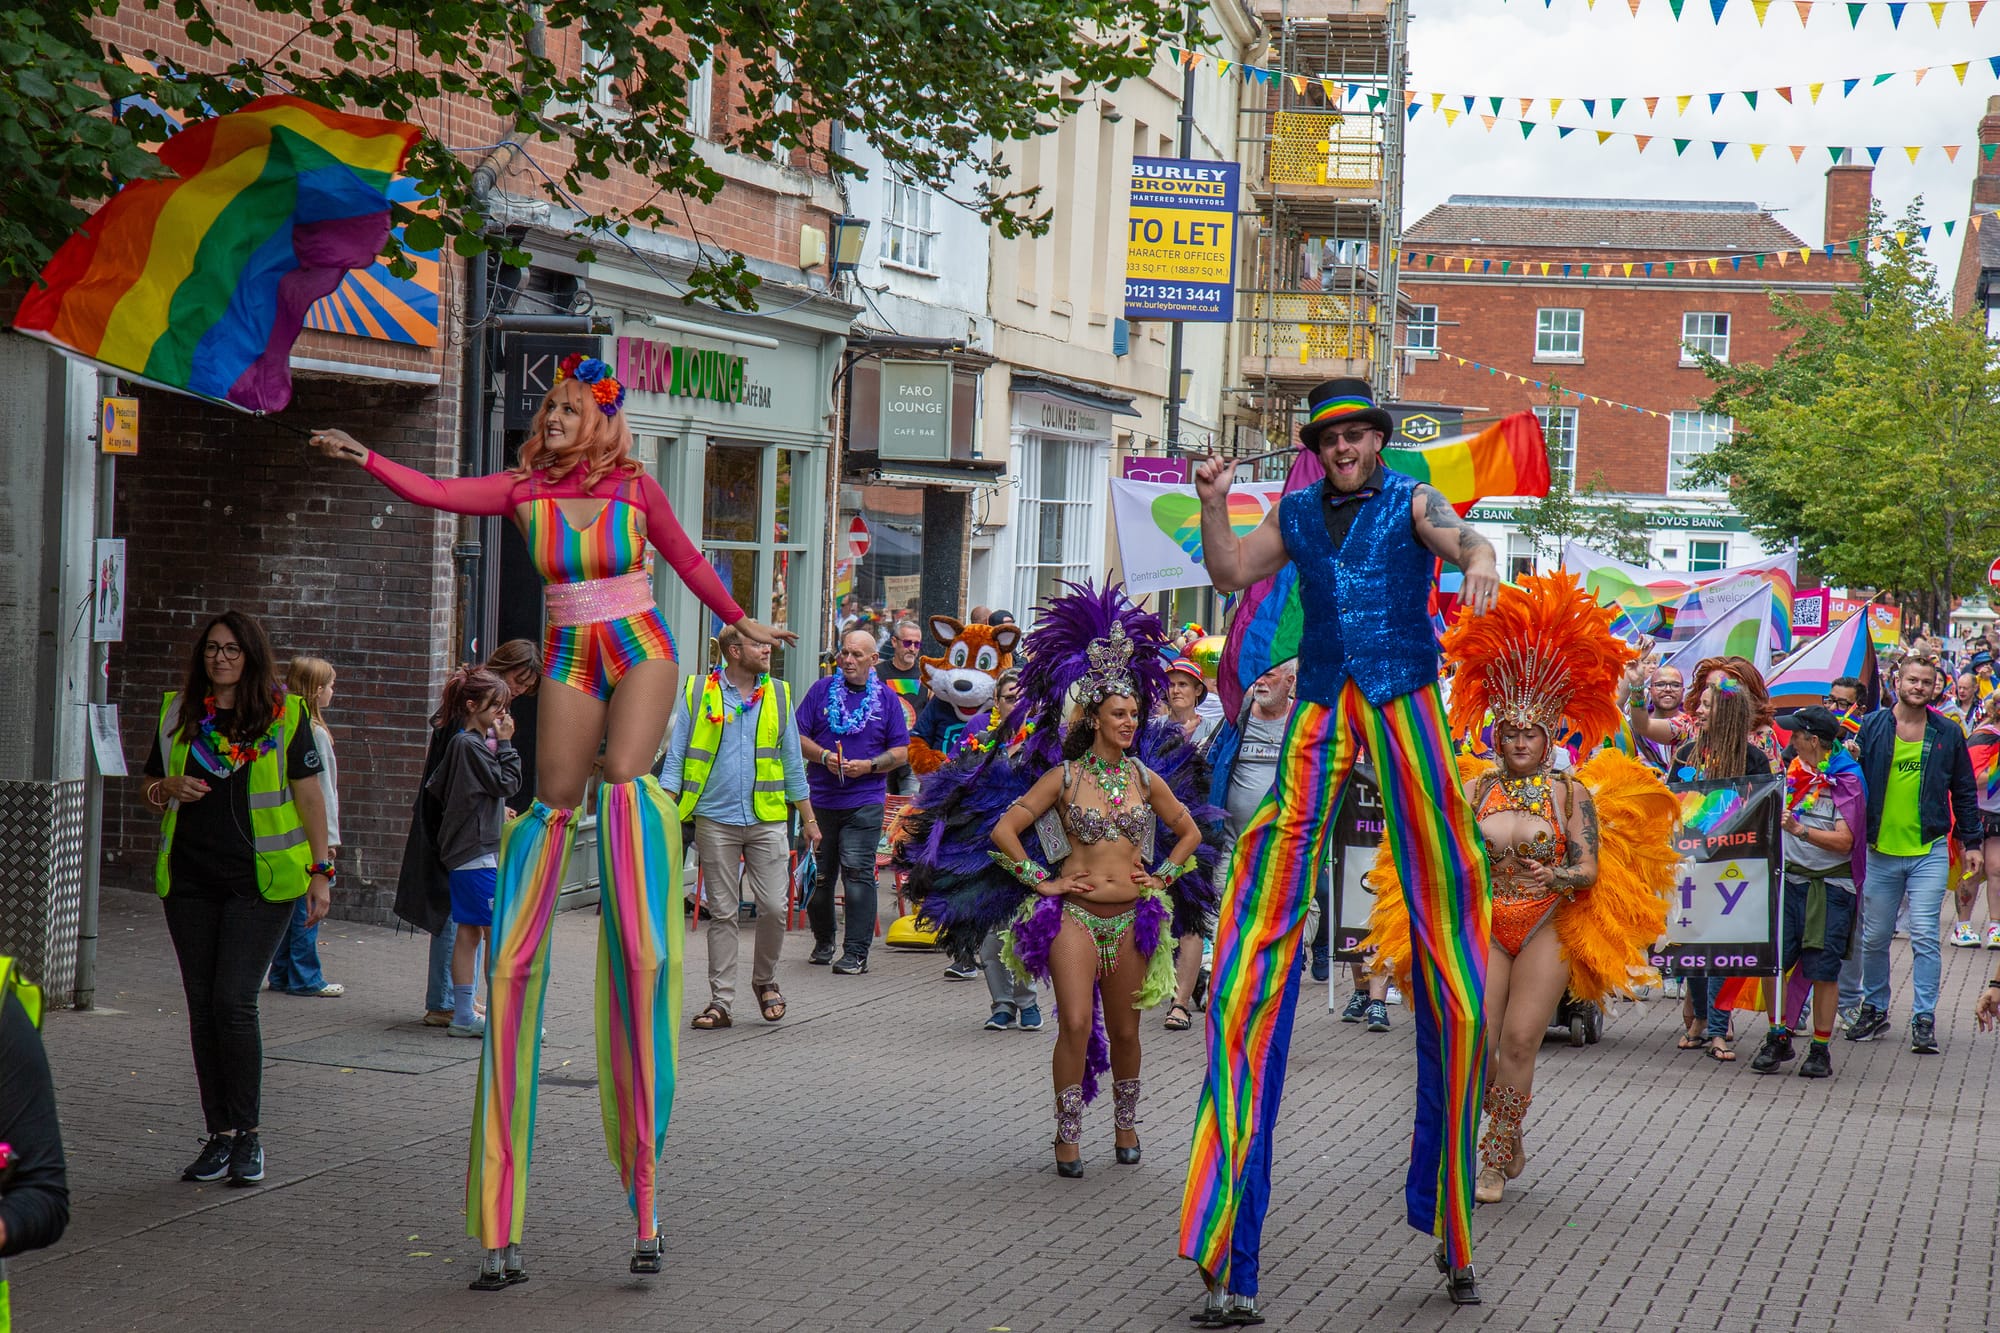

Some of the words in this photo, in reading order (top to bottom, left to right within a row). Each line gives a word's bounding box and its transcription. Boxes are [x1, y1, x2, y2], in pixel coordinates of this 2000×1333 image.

[1132, 164, 1228, 181] BURLEY
[1131, 179, 1224, 194] BROWNE
[1178, 197, 1225, 206] SURVEYORS
[1128, 218, 1163, 244] TO
[1173, 221, 1225, 247] LET
[1127, 248, 1181, 260] HARACTER
[1184, 251, 1226, 262] OFFICES
[1125, 284, 1155, 298] 0121
[1158, 286, 1183, 300] 321
[1185, 288, 1221, 302] 3441
[618, 337, 674, 394] FARO
[673, 345, 749, 404] LOUNGE
[759, 386, 772, 409] BAR
[899, 385, 934, 397] FARO
[888, 401, 943, 414] LOUNGE
[1042, 403, 1063, 429] COLIN
[1064, 408, 1077, 431] LEE
[919, 428, 936, 437] BAR
[1483, 510, 1515, 520] BANK
[1644, 512, 1689, 526] LLOYDS
[1692, 517, 1724, 528] BANK
[1717, 592, 1749, 603] welco
[1678, 839, 1702, 851] OF
[1707, 832, 1758, 849] PRIDE
[1680, 954, 1706, 968] as
[1714, 954, 1759, 968] one
